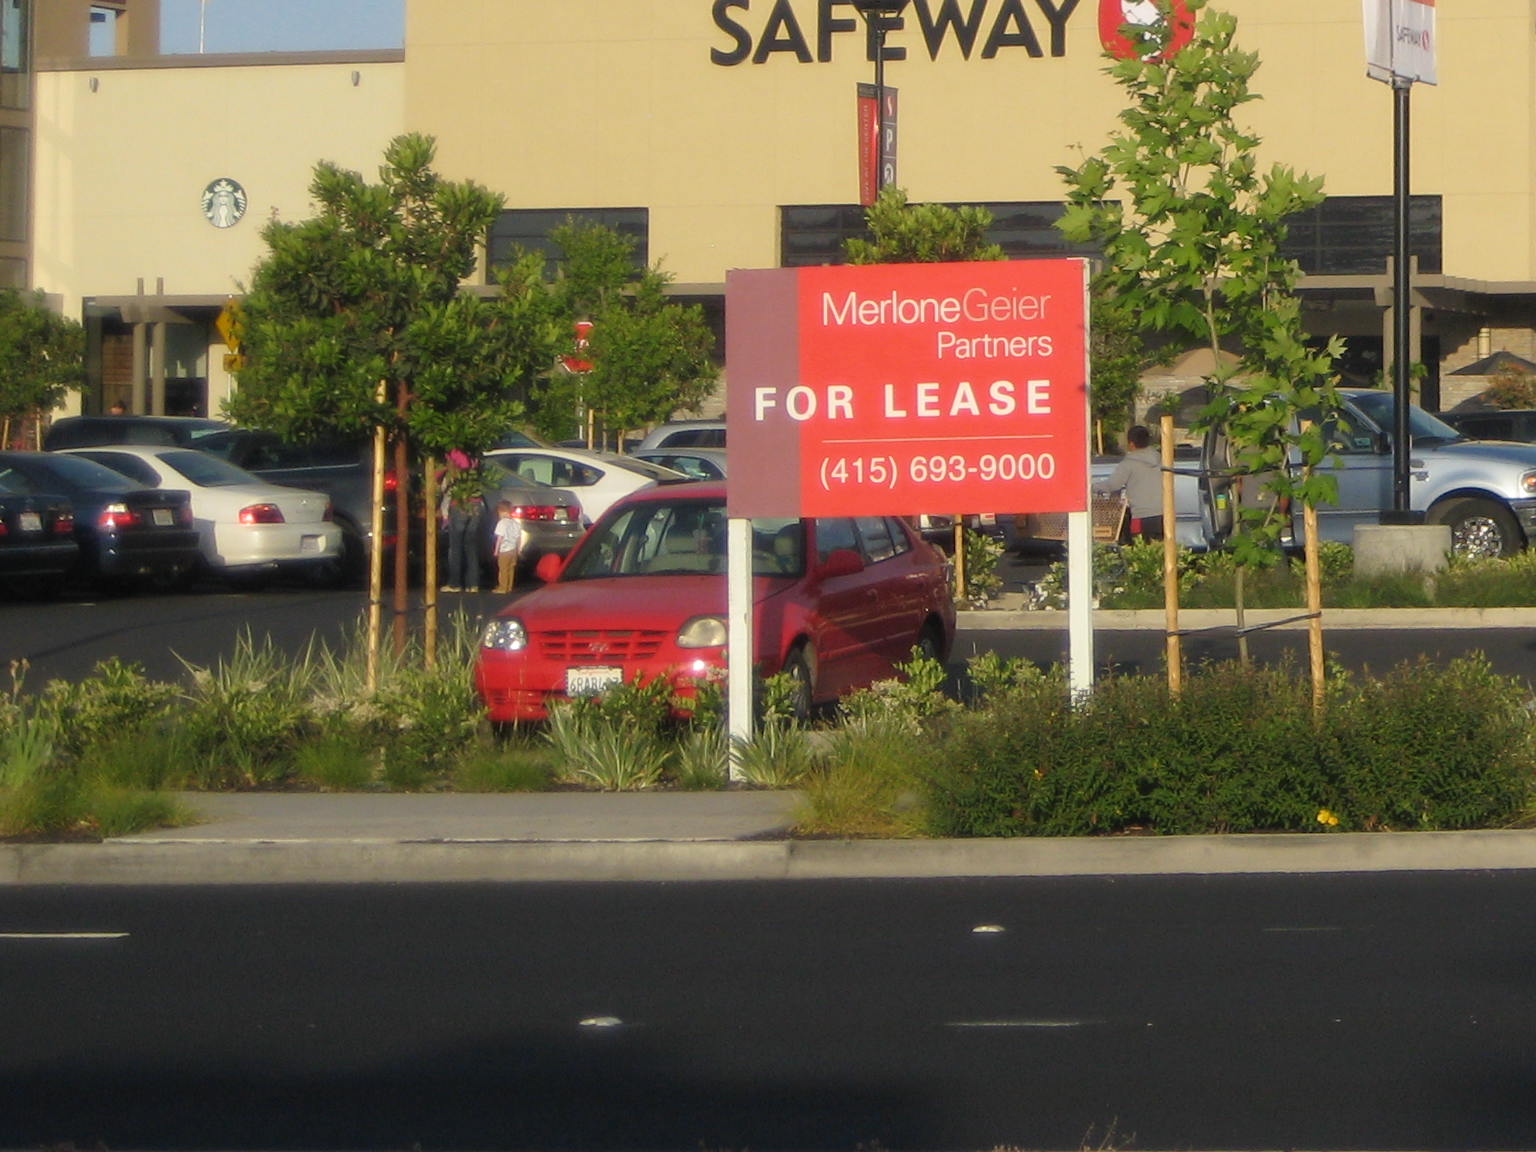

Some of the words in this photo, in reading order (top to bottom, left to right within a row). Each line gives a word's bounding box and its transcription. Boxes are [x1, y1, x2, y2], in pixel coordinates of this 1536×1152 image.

[937, 331, 1054, 360] Partners
[754, 384, 854, 422] FOR
[884, 379, 1053, 419] LEASE
[819, 456, 898, 491] (415)
[909, 452, 1056, 484] 693-9000
